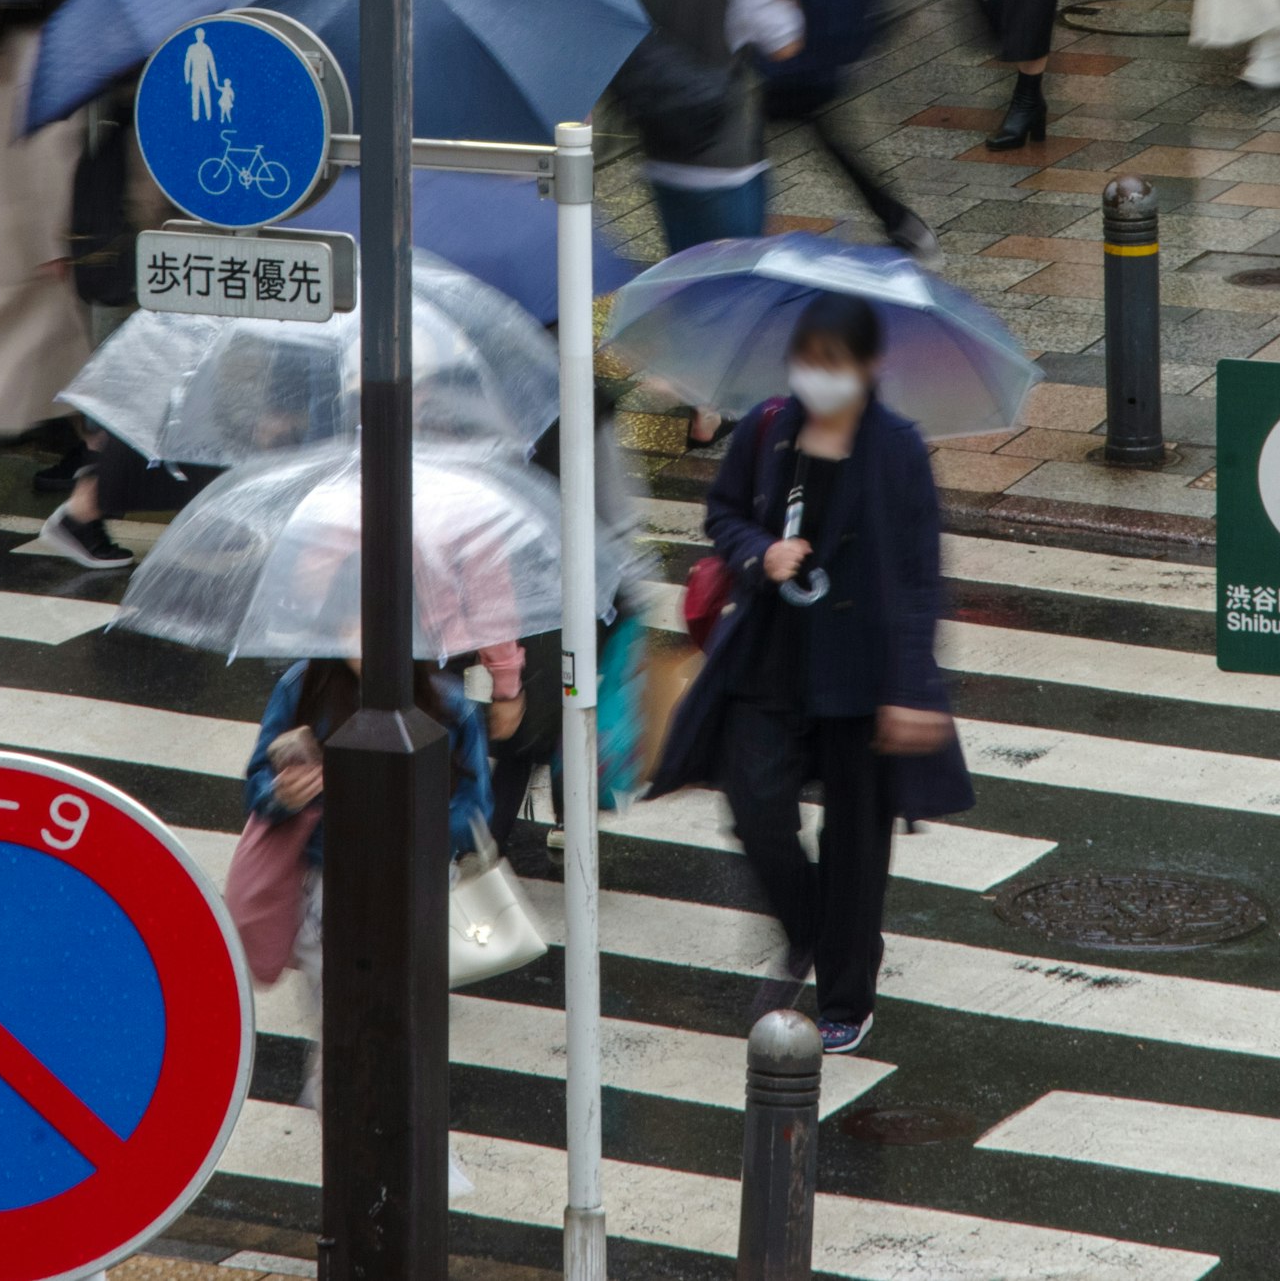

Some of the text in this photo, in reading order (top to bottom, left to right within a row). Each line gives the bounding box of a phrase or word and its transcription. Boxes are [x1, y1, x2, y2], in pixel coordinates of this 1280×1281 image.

[148, 251, 321, 305] 歩行者優先
